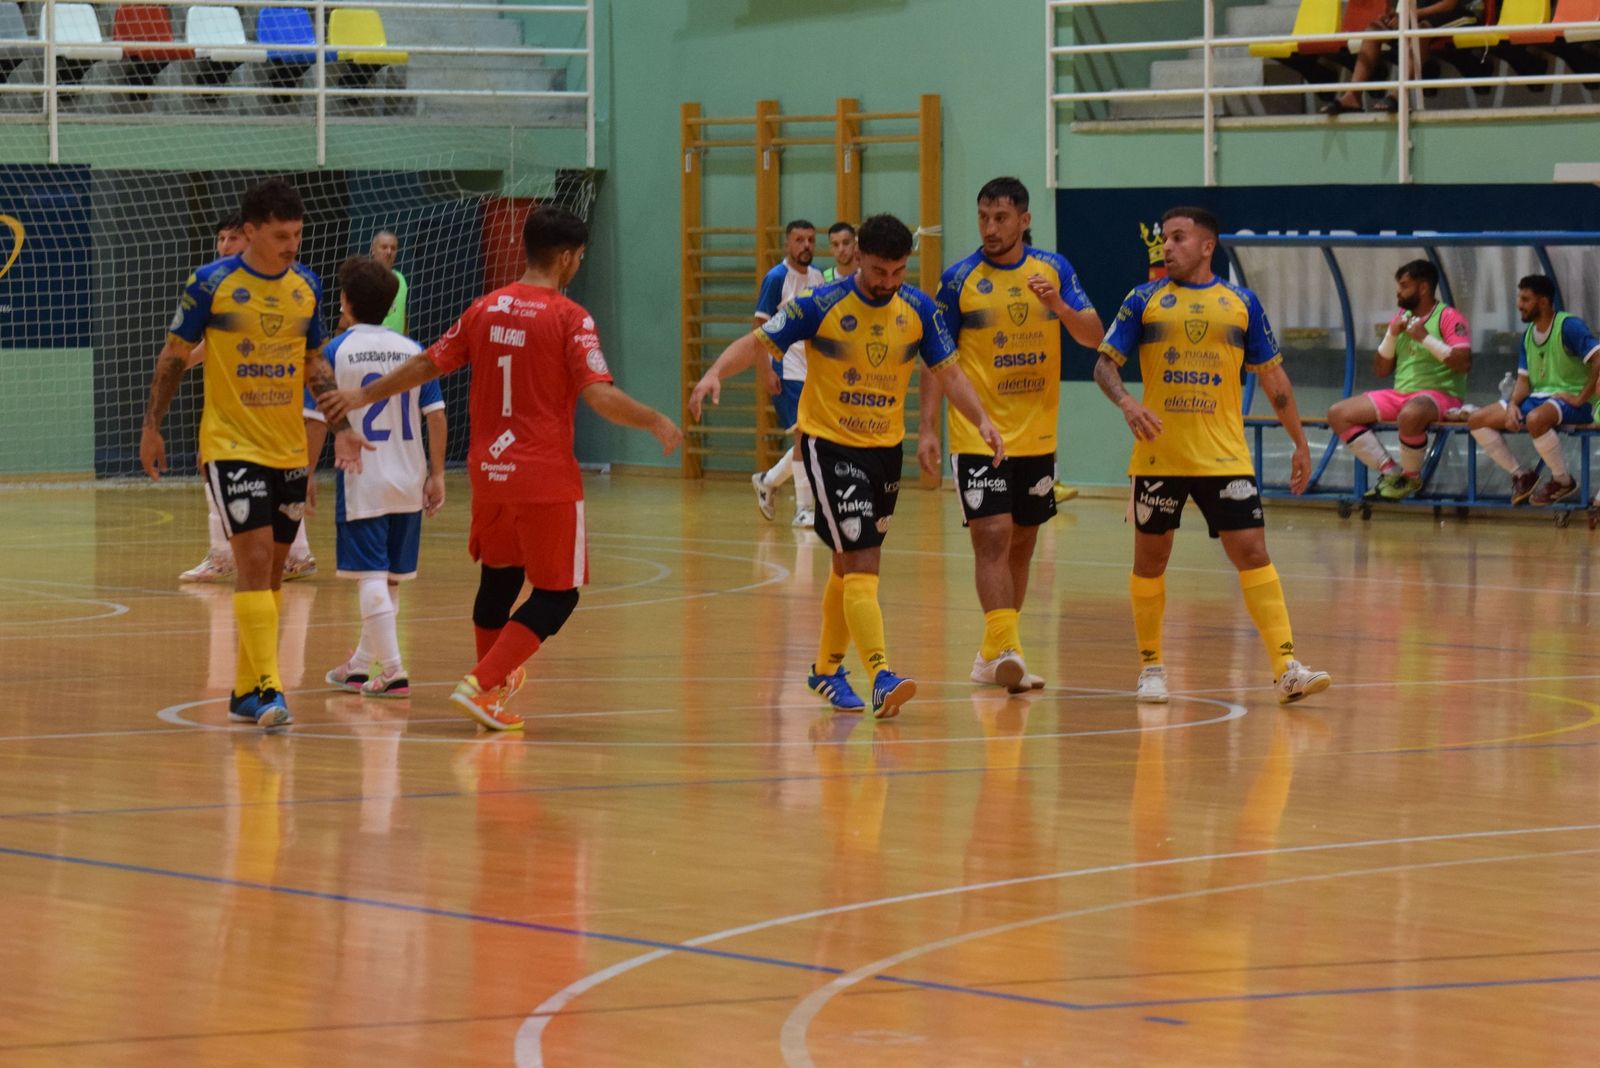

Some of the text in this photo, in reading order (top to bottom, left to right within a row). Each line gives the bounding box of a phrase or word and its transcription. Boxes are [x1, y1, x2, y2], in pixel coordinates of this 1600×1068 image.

[497, 354, 512, 417] 1
[359, 372, 414, 442] 21
[967, 477, 1007, 488] Halcón
[1139, 491, 1179, 507] Halcón
